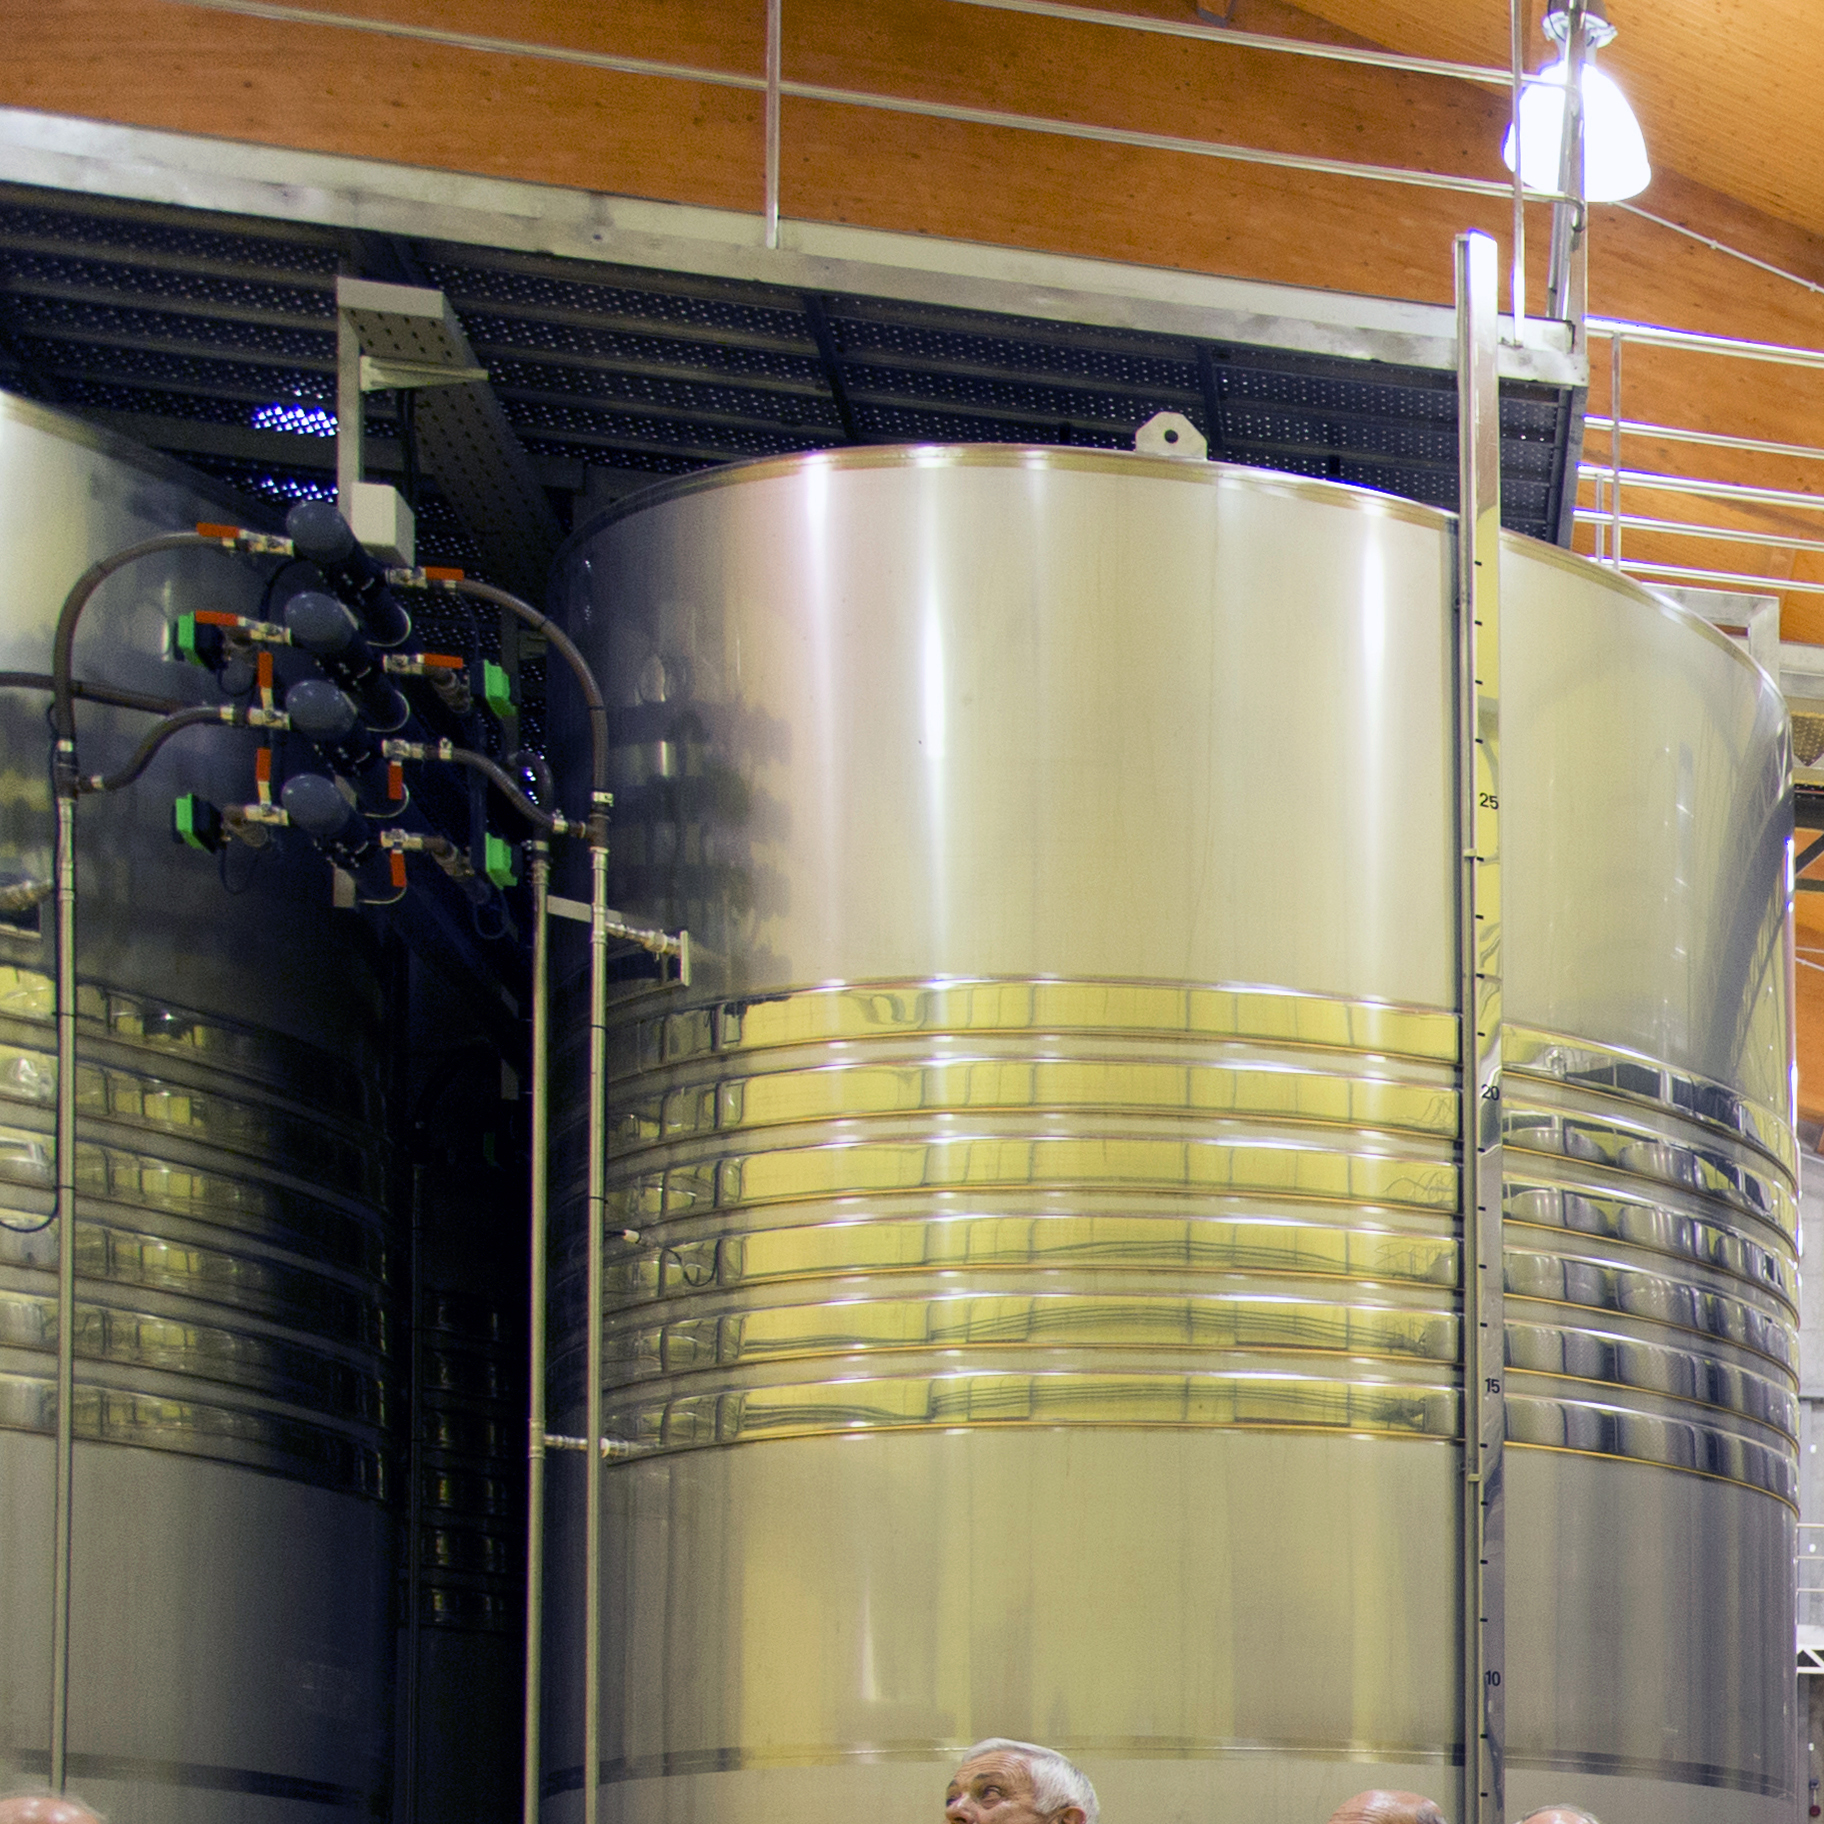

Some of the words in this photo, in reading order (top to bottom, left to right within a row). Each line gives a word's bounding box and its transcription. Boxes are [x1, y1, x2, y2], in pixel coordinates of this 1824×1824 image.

[1479, 792, 1499, 810] 25
[1481, 1083, 1500, 1101] 20
[1485, 1377, 1501, 1394] 15
[1485, 1670, 1501, 1687] 10
